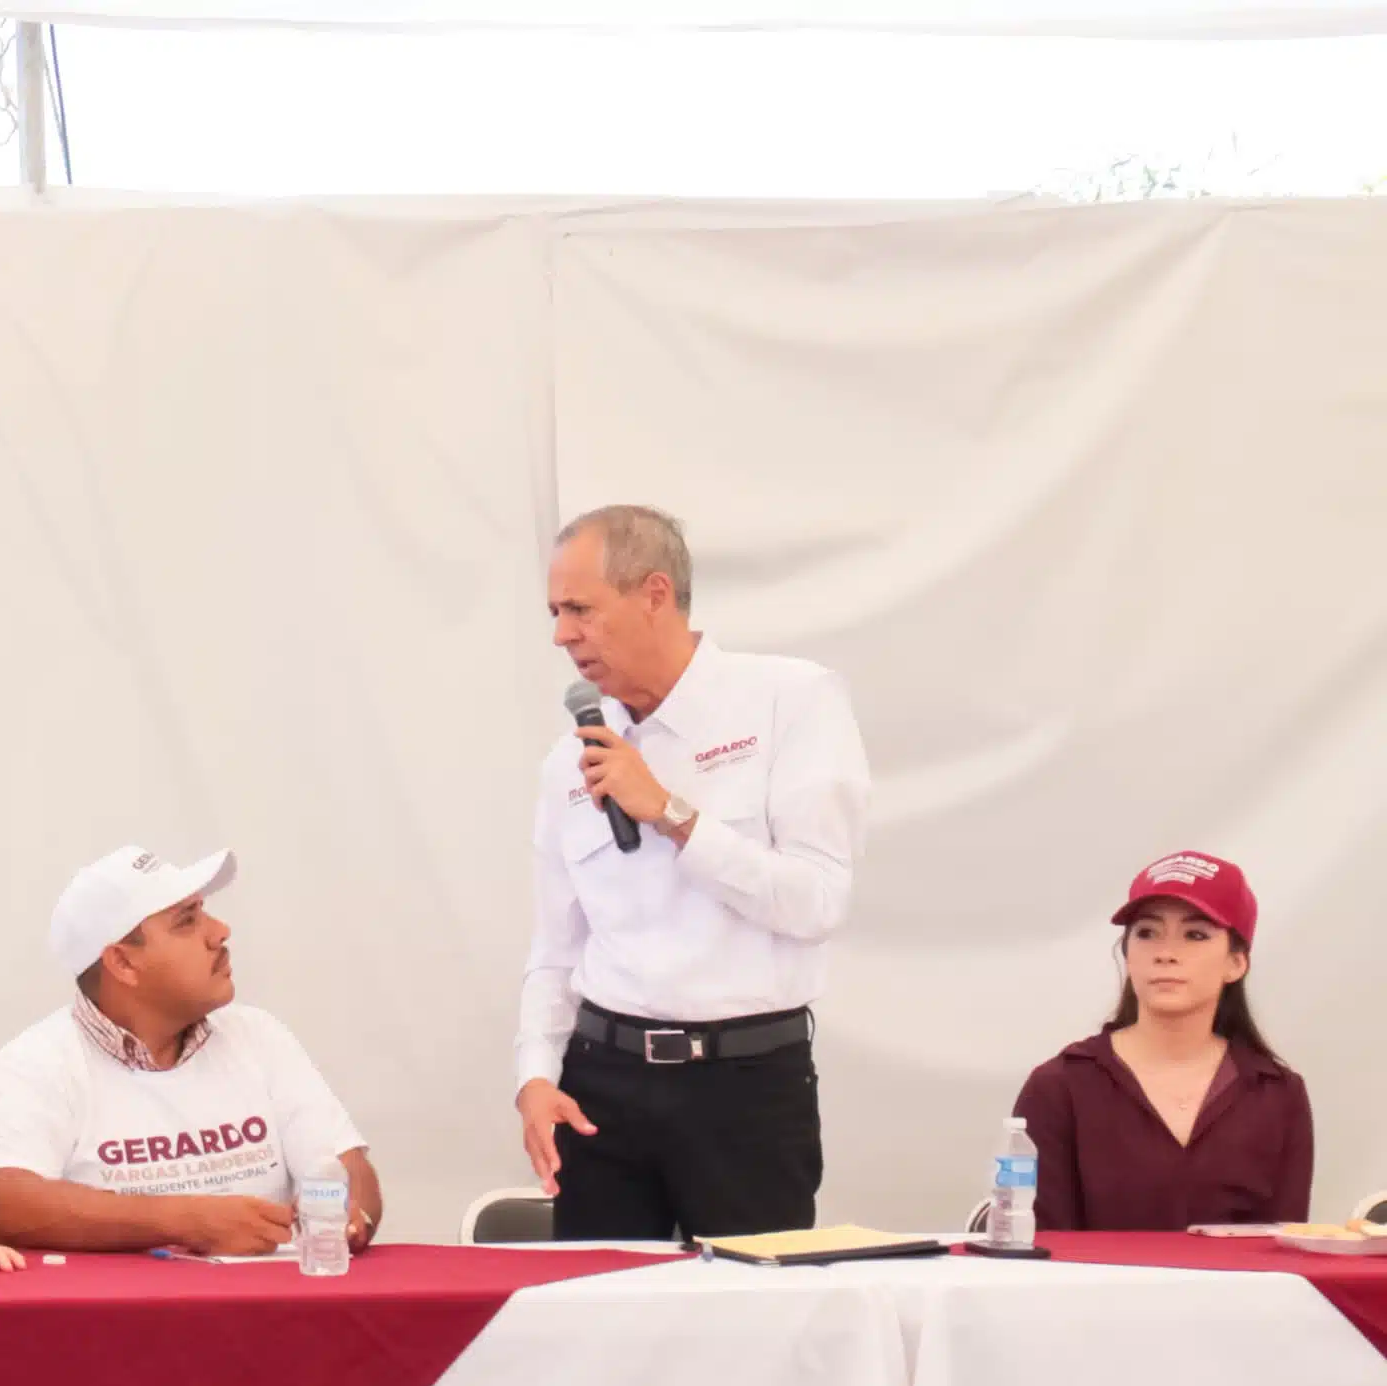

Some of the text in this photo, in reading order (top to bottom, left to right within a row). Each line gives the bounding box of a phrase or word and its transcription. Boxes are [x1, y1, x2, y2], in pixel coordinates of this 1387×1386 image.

[694, 735, 759, 764] GERARDO
[97, 1115, 268, 1166] GERARDO
[99, 1163, 181, 1184] VARGAS
[119, 1176, 203, 1197] PRESIDENTE
